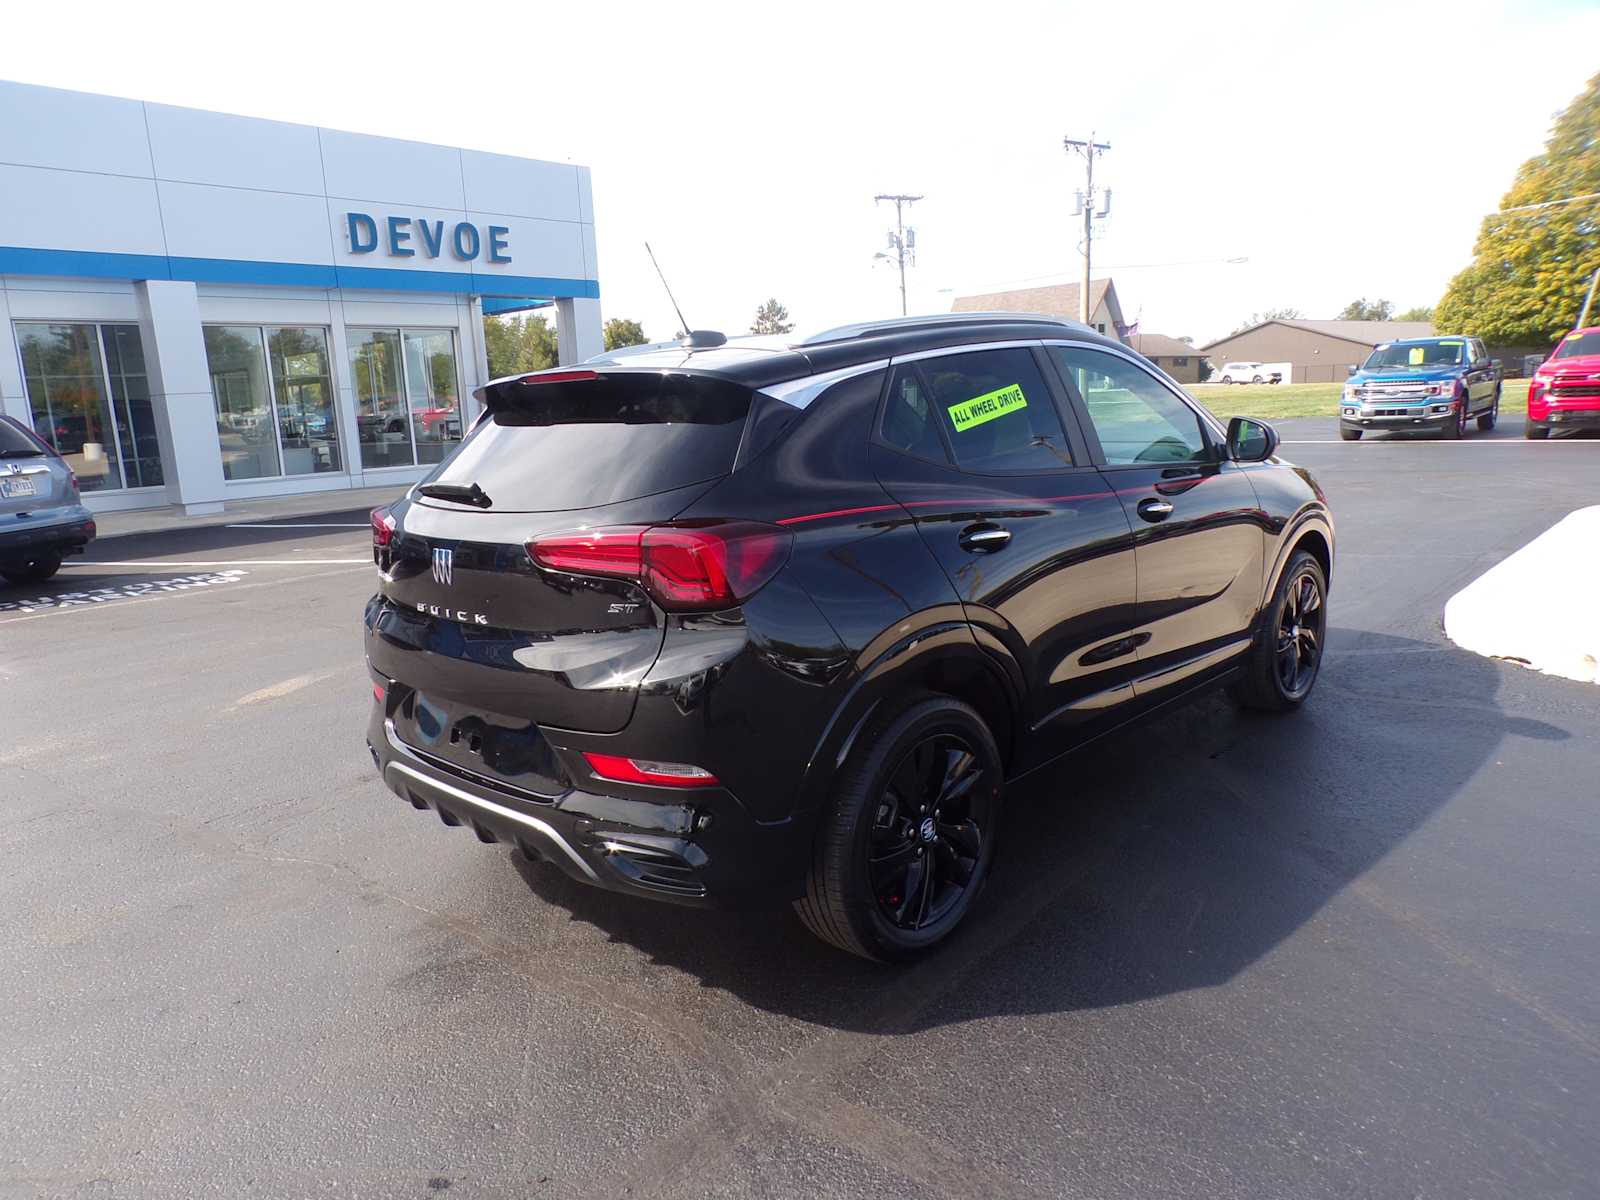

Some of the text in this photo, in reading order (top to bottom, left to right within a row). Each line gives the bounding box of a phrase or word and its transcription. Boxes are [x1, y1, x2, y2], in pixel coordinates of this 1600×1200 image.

[346, 212, 512, 264] DEVOE
[954, 389, 1022, 425] ALL WHEEL DRIVE
[19, 576, 241, 612] PARKING
[607, 603, 639, 614] ST
[416, 602, 488, 625] BUICK
